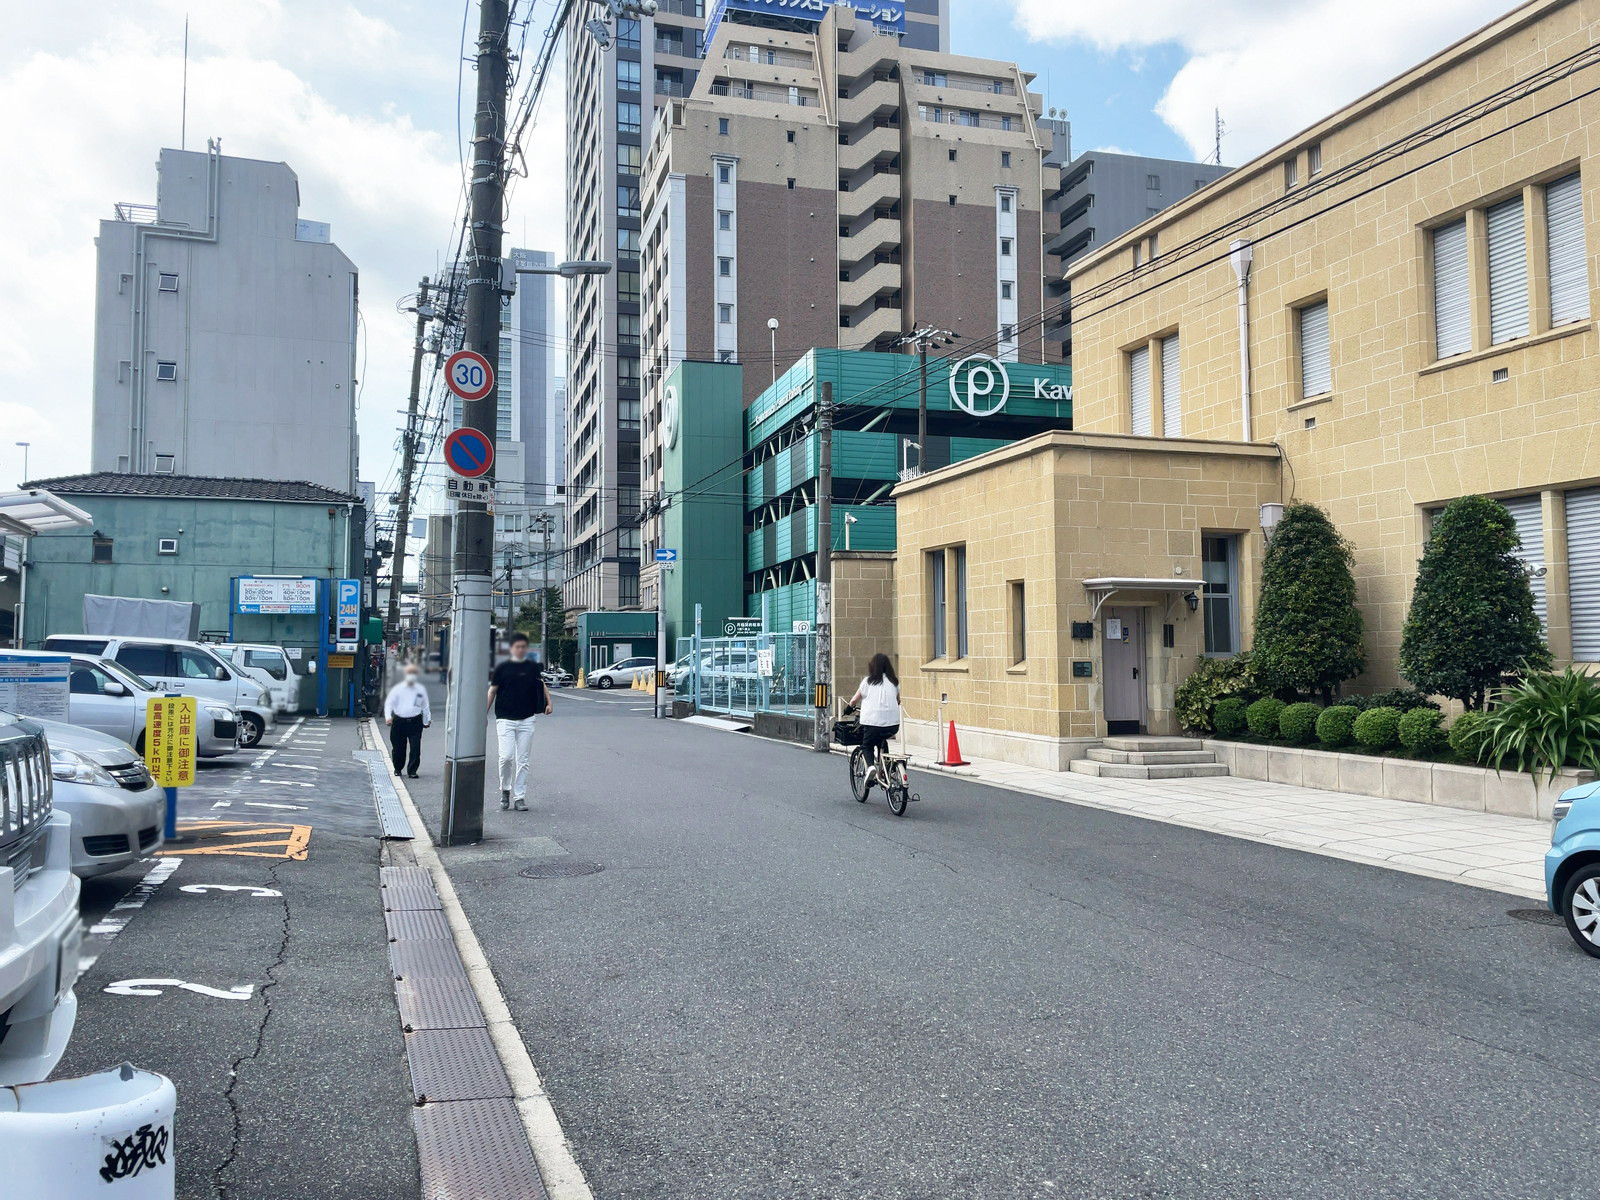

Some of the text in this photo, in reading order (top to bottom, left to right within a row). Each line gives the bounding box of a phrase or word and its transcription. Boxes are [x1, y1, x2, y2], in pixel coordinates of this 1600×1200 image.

[455, 363, 483, 387] 30
[448, 479, 488, 492] 自動車
[341, 585, 357, 602] P
[340, 604, 357, 615] 24H
[177, 703, 191, 781] 入出庫に御注意
